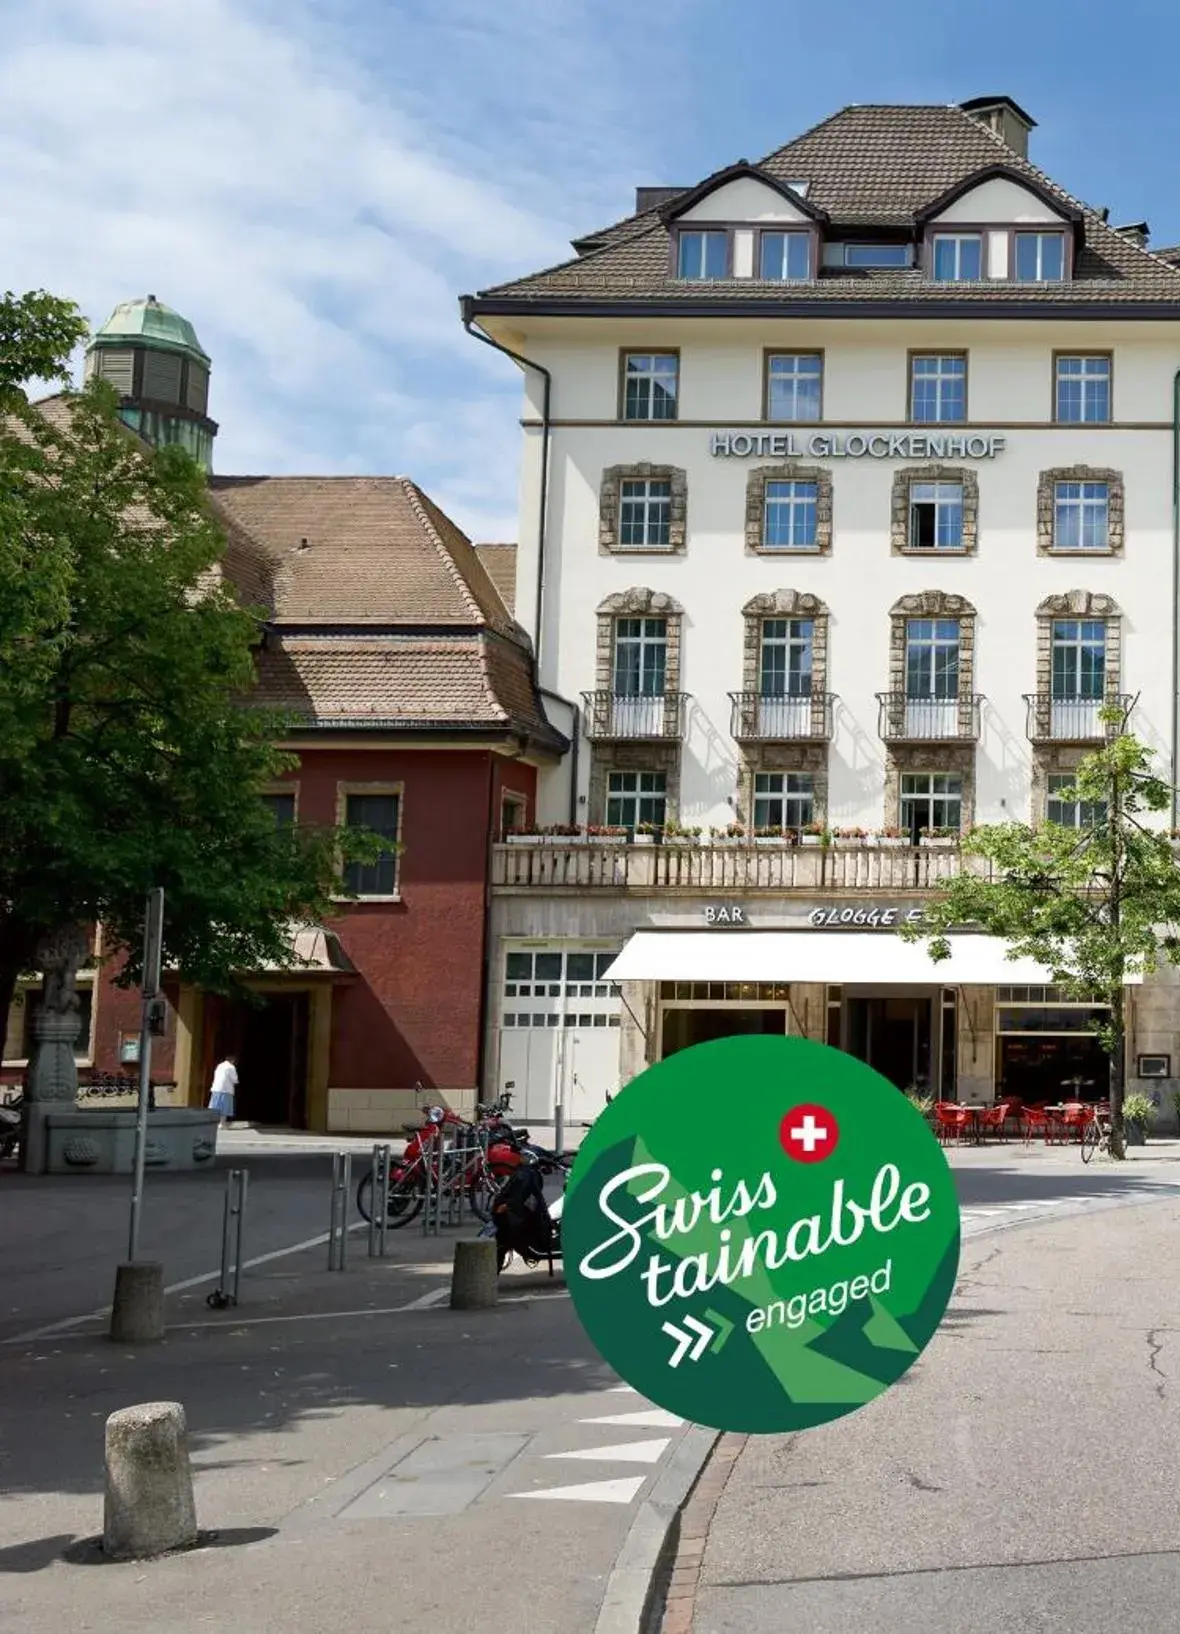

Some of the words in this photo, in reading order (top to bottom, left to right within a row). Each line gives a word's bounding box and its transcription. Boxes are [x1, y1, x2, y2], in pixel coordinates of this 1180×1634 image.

[711, 433, 804, 458] HOTEL
[809, 433, 1006, 459] GLOCKENHOF
[704, 906, 744, 922] BAR
[808, 907, 899, 926] GLOGGE
